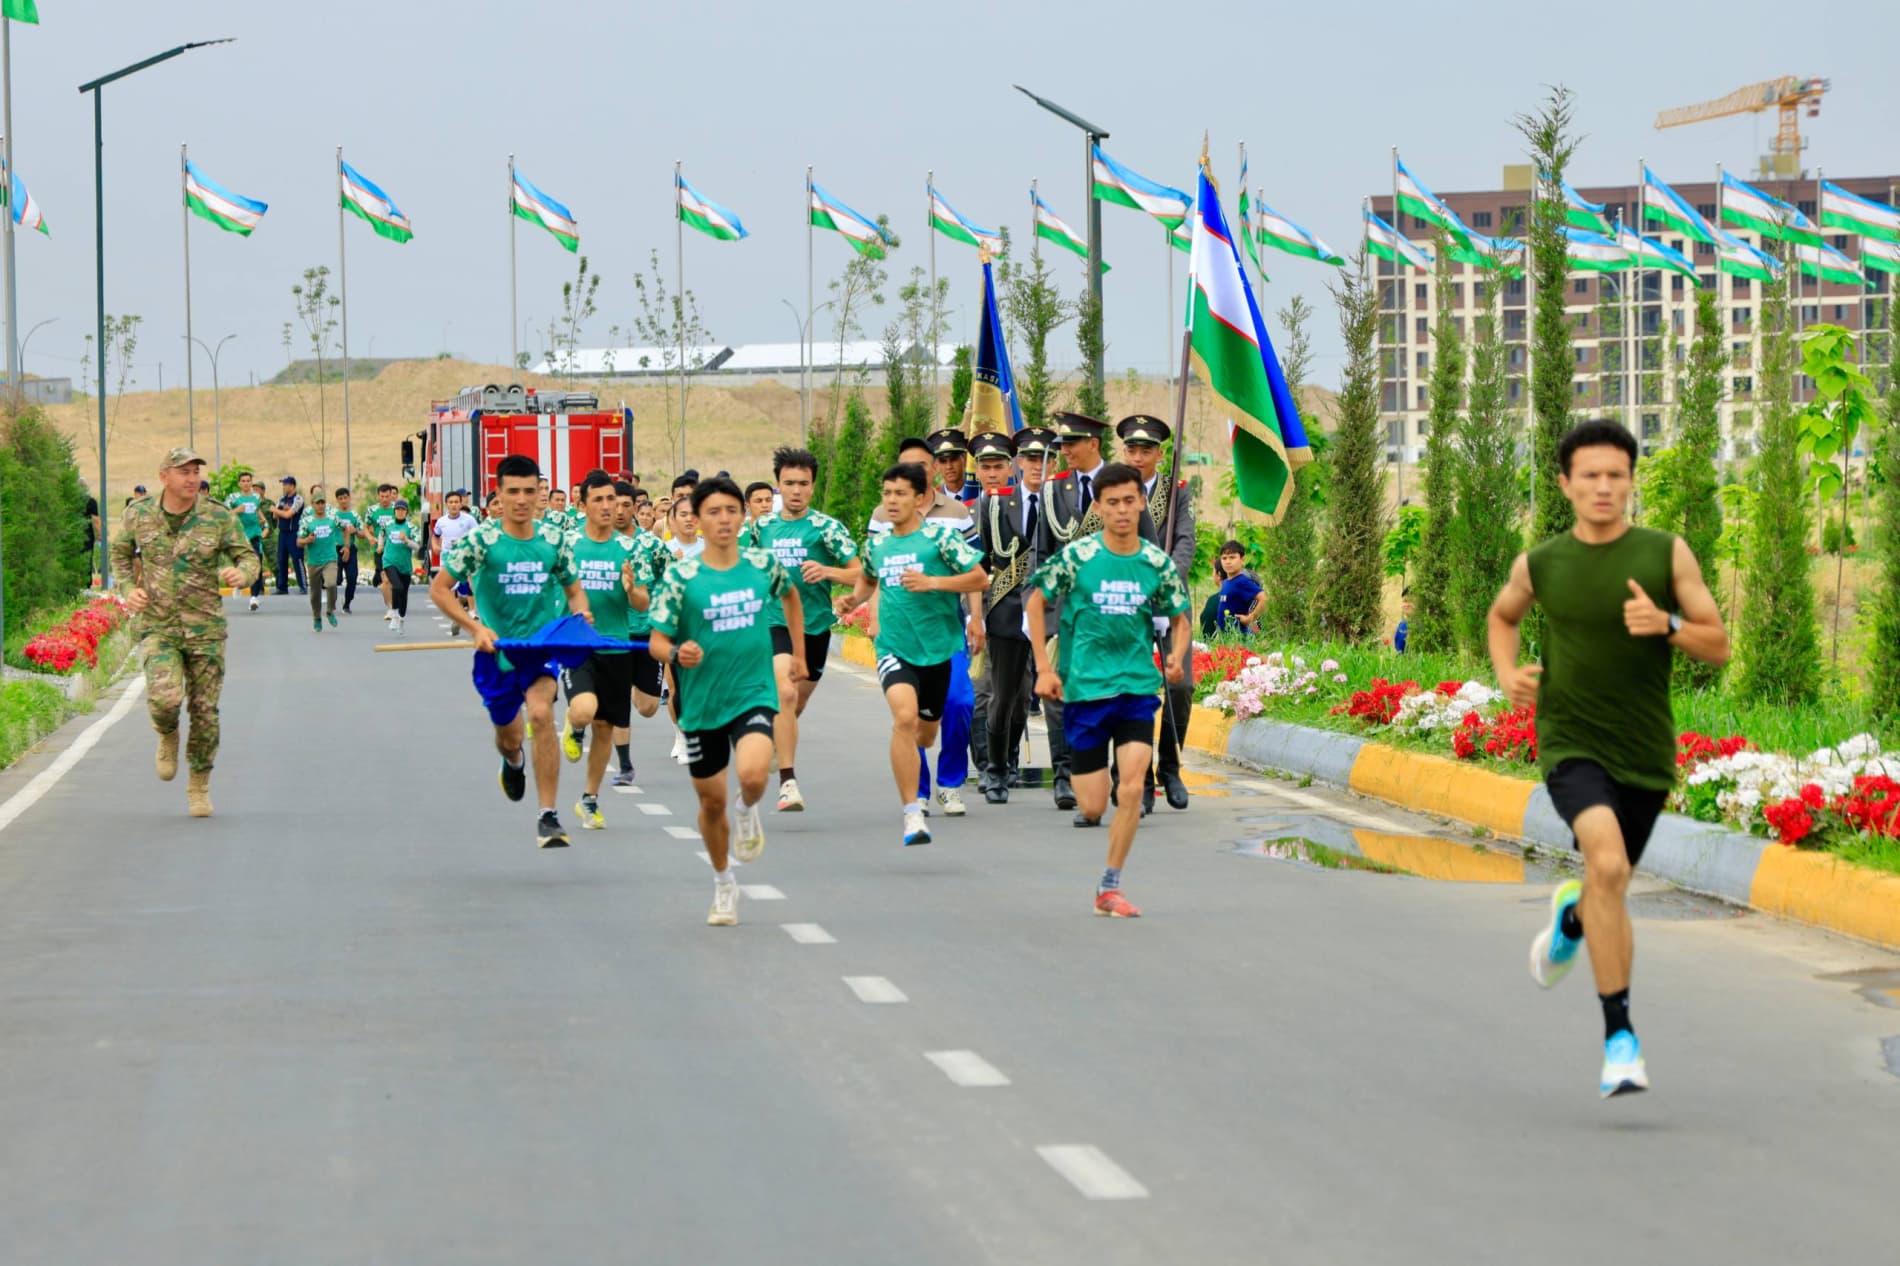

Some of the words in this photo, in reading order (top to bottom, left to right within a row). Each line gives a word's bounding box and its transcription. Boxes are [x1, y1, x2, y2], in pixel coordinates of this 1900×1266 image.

[772, 537, 802, 548] MEN
[581, 559, 615, 570] MEN
[781, 557, 803, 568] UN
[883, 552, 918, 566] MEN
[507, 561, 543, 573] MEN
[505, 584, 542, 595] RUN
[580, 580, 614, 591] RUN
[1100, 579, 1141, 593] MEN
[710, 588, 755, 607] MEN
[703, 599, 764, 620] G'OLIB
[713, 613, 755, 632] RUN
